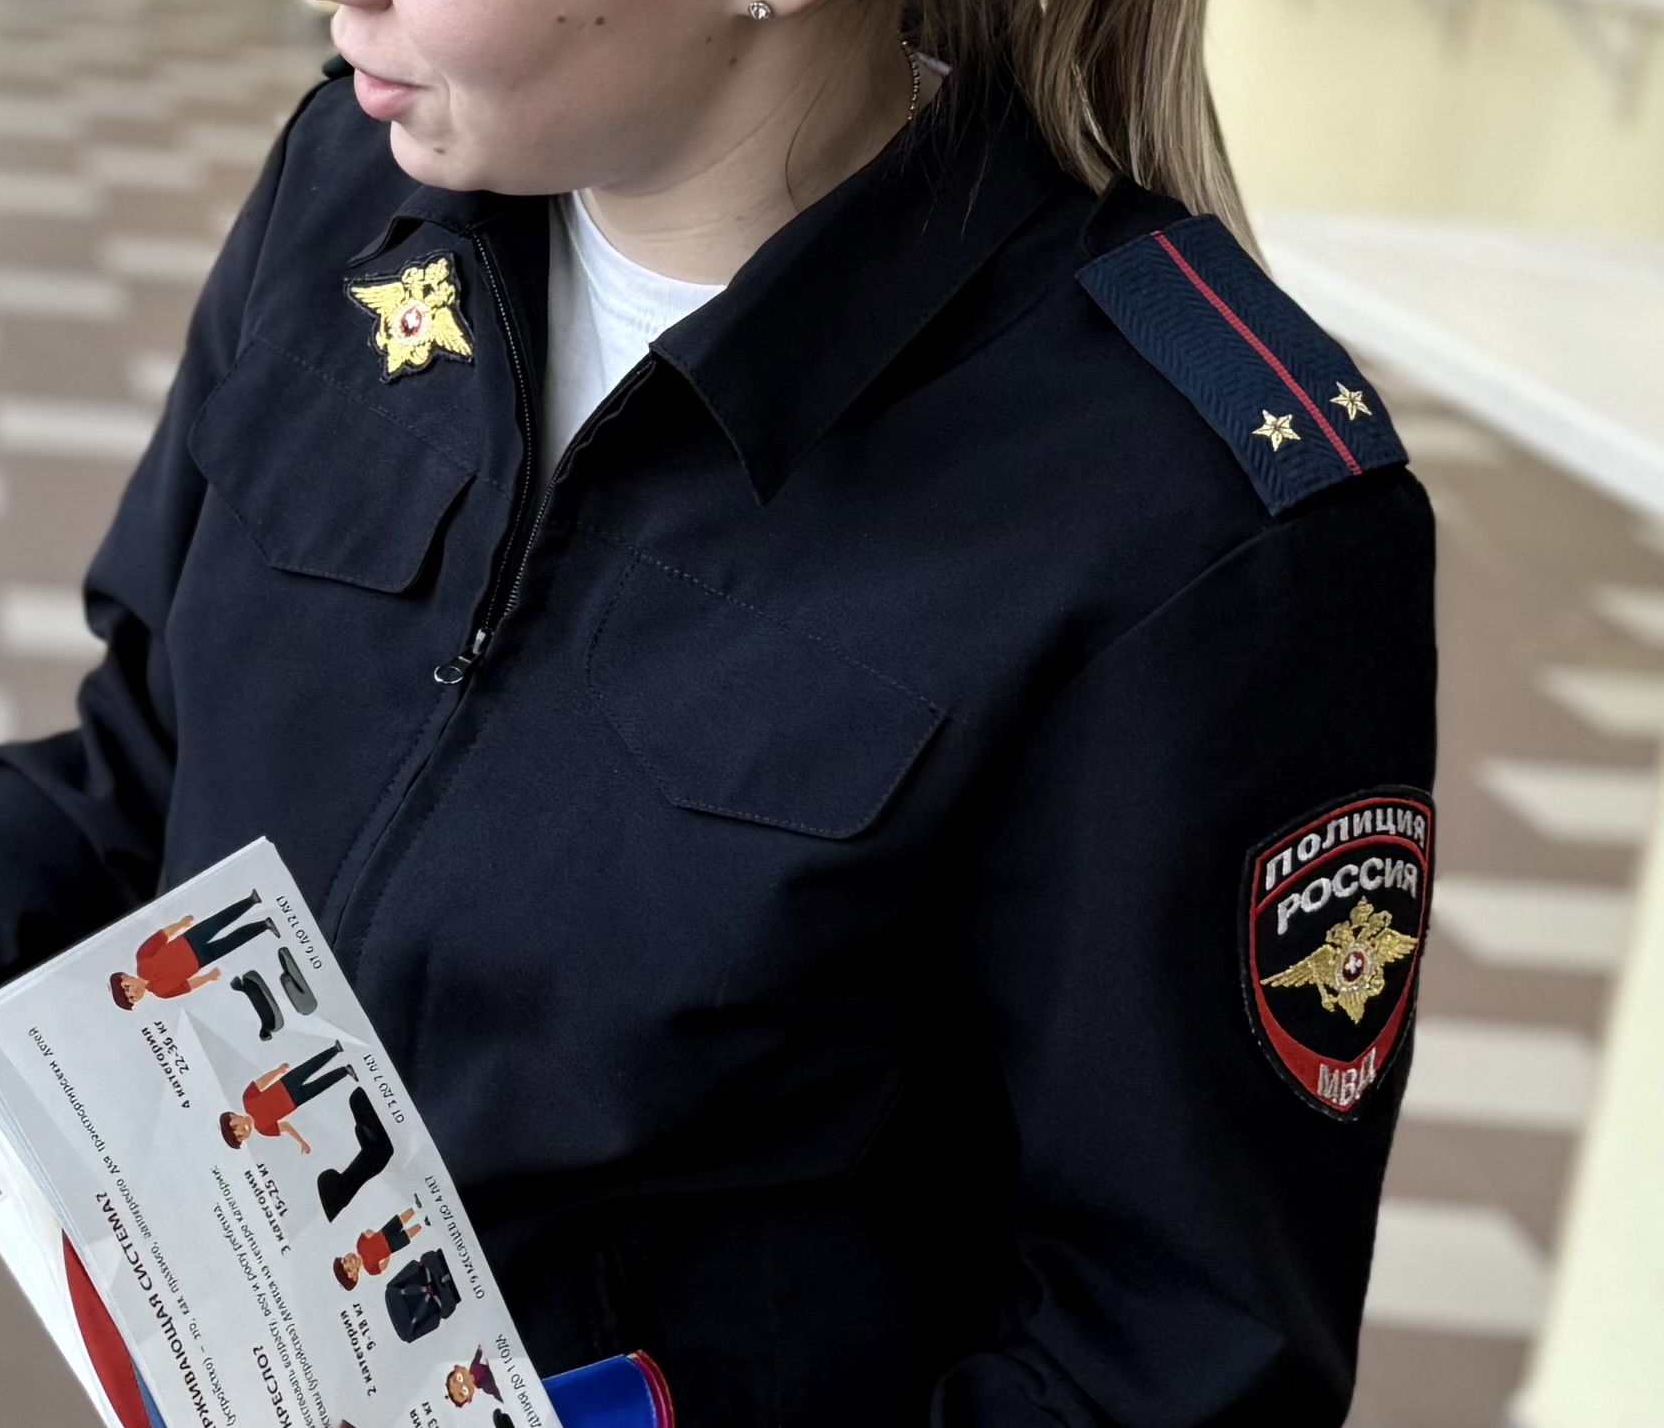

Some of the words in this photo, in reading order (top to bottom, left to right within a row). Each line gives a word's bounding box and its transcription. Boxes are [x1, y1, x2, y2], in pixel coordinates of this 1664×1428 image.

[1266, 808, 1426, 891] ПОЛИЦИЯ
[1277, 857, 1418, 936] РОССИЯ
[141, 1026, 186, 1098] категория
[153, 1020, 168, 1035] кг
[1316, 1047, 1377, 1106] МВД
[244, 1169, 285, 1243] категория
[255, 1163, 269, 1177] кг
[95, 1191, 153, 1292] СИСТЕМА?
[352, 1302, 364, 1318] кг
[340, 1309, 373, 1384] категория
[421, 1401, 433, 1416] кг
